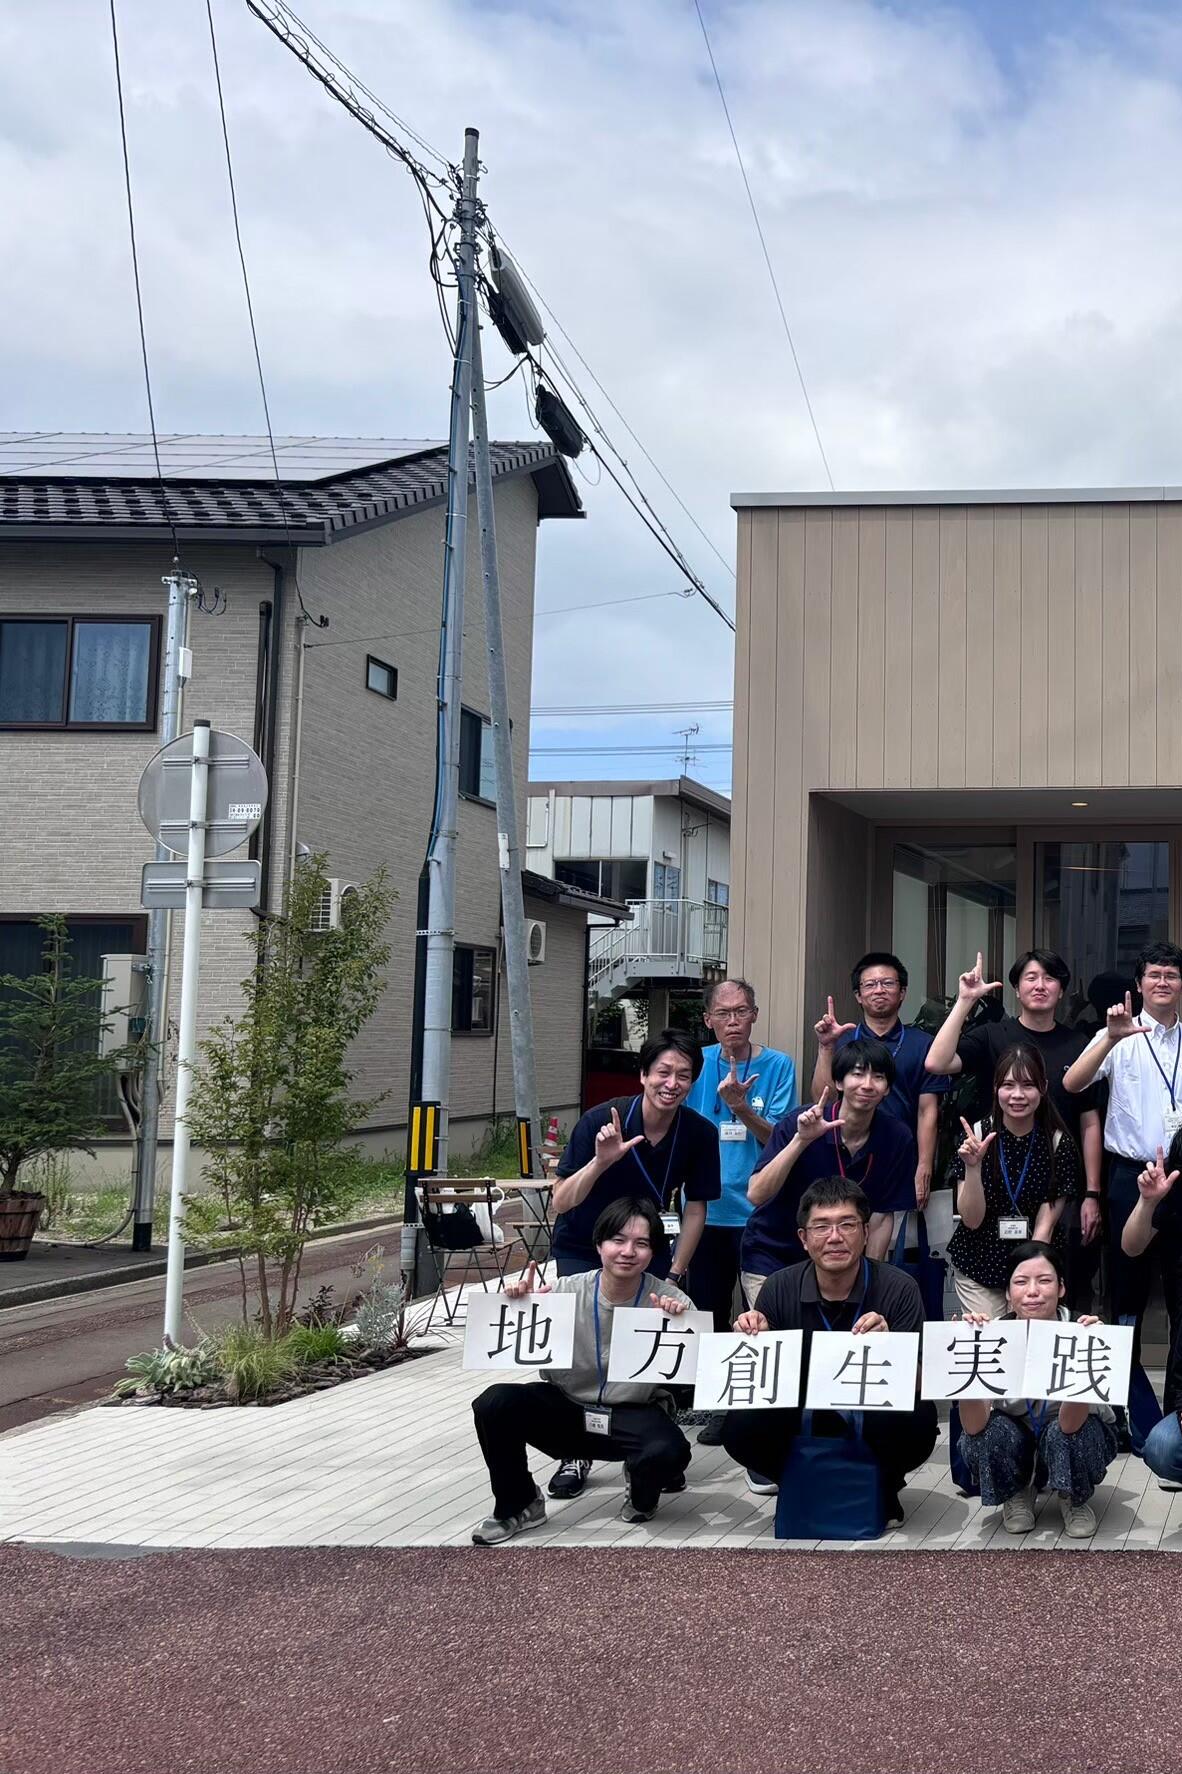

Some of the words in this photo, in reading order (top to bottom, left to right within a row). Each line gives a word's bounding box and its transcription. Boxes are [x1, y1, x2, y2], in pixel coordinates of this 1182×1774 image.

[488, 1303, 554, 1367] 地
[629, 1318, 694, 1381] 方
[945, 1330, 1009, 1398] 実
[717, 1340, 783, 1406] 創
[830, 1345, 893, 1408] 生
[1045, 1334, 1112, 1403] 践
